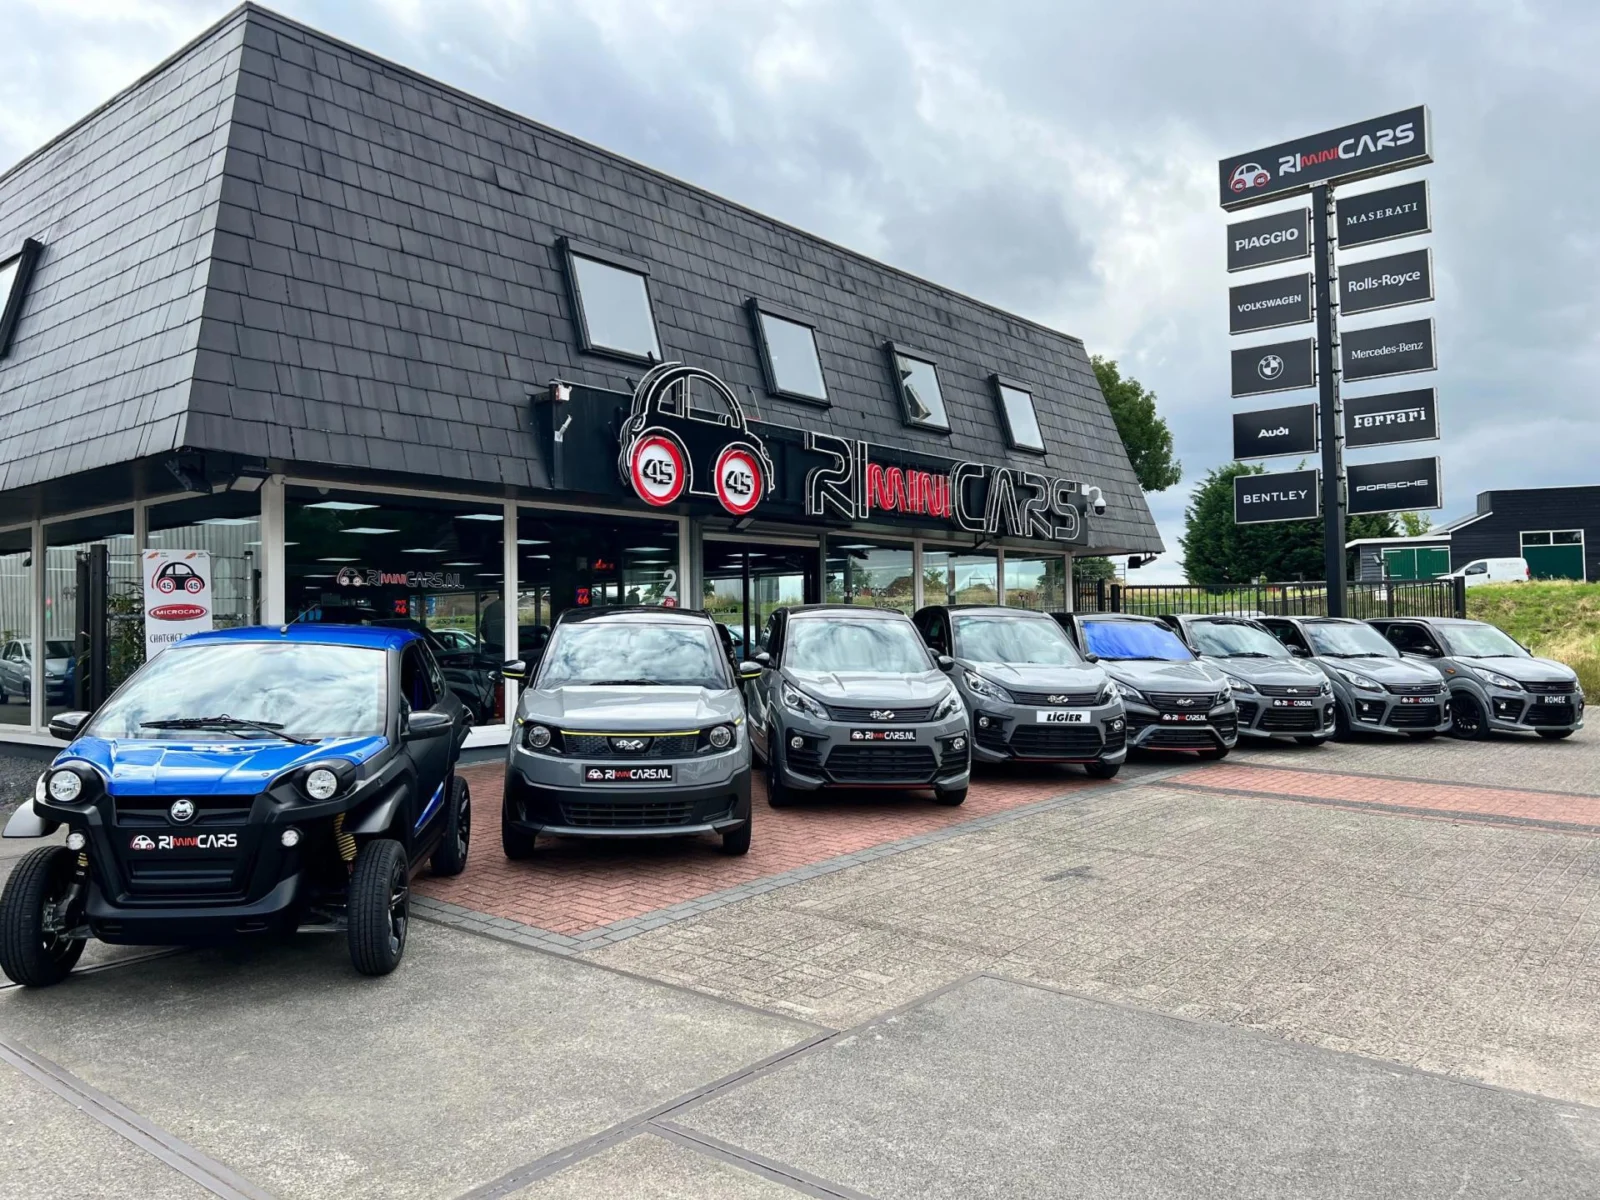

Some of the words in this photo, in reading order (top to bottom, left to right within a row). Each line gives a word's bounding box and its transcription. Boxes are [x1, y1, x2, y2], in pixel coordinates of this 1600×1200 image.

[1346, 202, 1418, 225] MASERATI
[1235, 228, 1299, 251] PIAGGIO
[1348, 270, 1421, 293] Rolls-Royce
[1237, 294, 1301, 313] VOLKSWAGEN
[1351, 341, 1424, 360] Mercedes-Benz
[1353, 407, 1426, 429] Ferrari
[1257, 426, 1289, 438] Audi
[642, 458, 675, 485] 45
[725, 470, 754, 495] 45
[1356, 479, 1428, 492] PORSCHE
[1243, 489, 1308, 504] BENTLEY
[161, 582, 172, 590] 45
[188, 582, 199, 590] 45
[663, 569, 677, 597] 2
[1544, 695, 1566, 704] ROMEE
